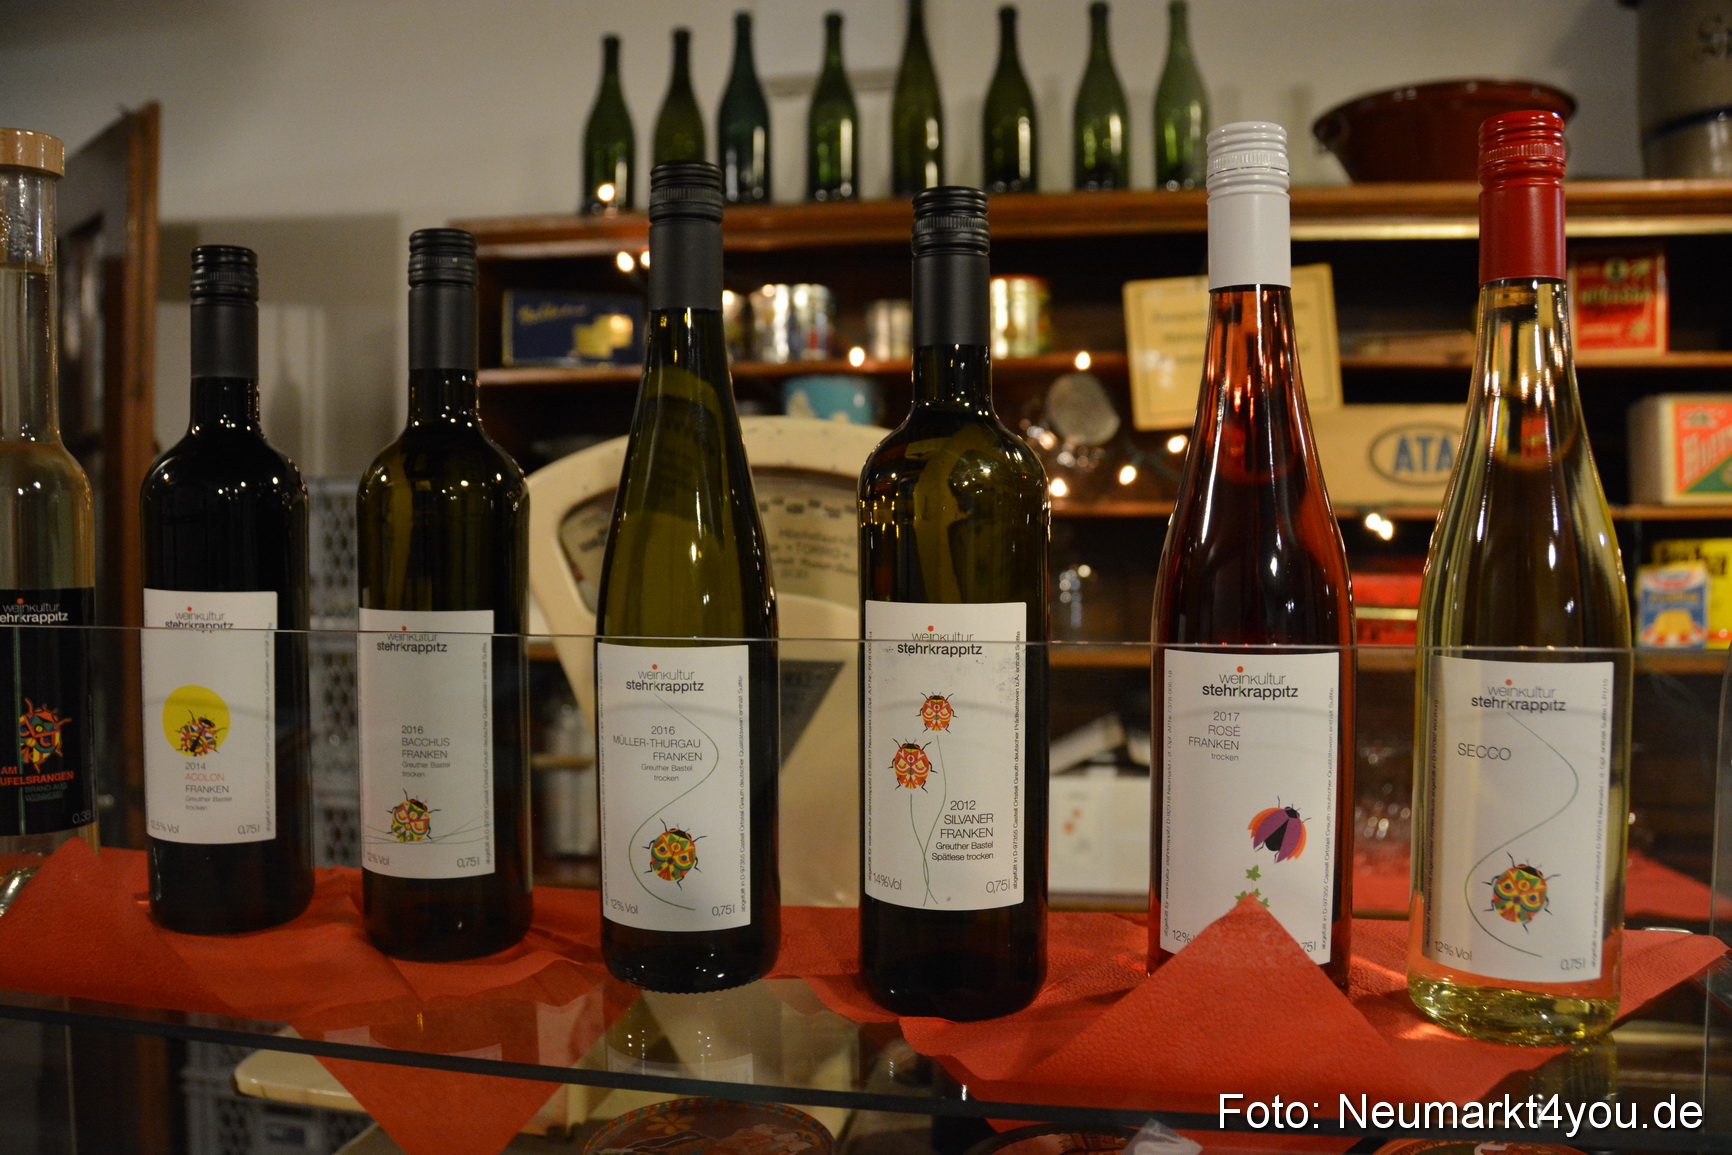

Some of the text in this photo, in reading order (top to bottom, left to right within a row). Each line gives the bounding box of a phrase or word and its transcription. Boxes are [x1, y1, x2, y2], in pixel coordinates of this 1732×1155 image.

[2, 600, 60, 613] weinkultur
[174, 608, 225, 621] weinkultur
[911, 629, 974, 642] weinkultur
[377, 642, 447, 654] stehrkrappitz
[897, 642, 983, 655] stehrkrappitz
[637, 667, 695, 681] weinkultur
[1219, 669, 1287, 685] weinkultur
[626, 680, 704, 692] stehrkrappitz
[1202, 684, 1299, 700] stehrkrappitz
[1487, 682, 1556, 698] weinkultur
[1471, 697, 1566, 714] stehrkrappitz
[1213, 711, 1240, 722] 2017
[401, 725, 424, 735] 2016
[651, 726, 675, 735] 2016
[1207, 724, 1241, 737] ROSÉ
[401, 738, 450, 747] BACCHUS
[612, 735, 701, 749] MÜLLER-THURGAU
[1188, 736, 1239, 750] FRANKEN
[401, 750, 448, 759] FRANKEN
[652, 752, 702, 761] FRANKEN
[1211, 752, 1239, 761] trocken
[1457, 742, 1512, 761] SECCO
[1, 766, 18, 775] AM
[185, 761, 206, 770] 2014
[641, 763, 669, 772] Greuther
[0, 771, 75, 786] UFELSRANGEN
[185, 773, 224, 782] ACOLON
[185, 785, 229, 793] FRANKEN
[950, 800, 976, 811] 2012
[944, 813, 994, 825] SILVANER
[940, 827, 994, 839] FRANKEN
[935, 841, 994, 851] Greuther Bastel
[931, 851, 994, 861] Spätlese trocken
